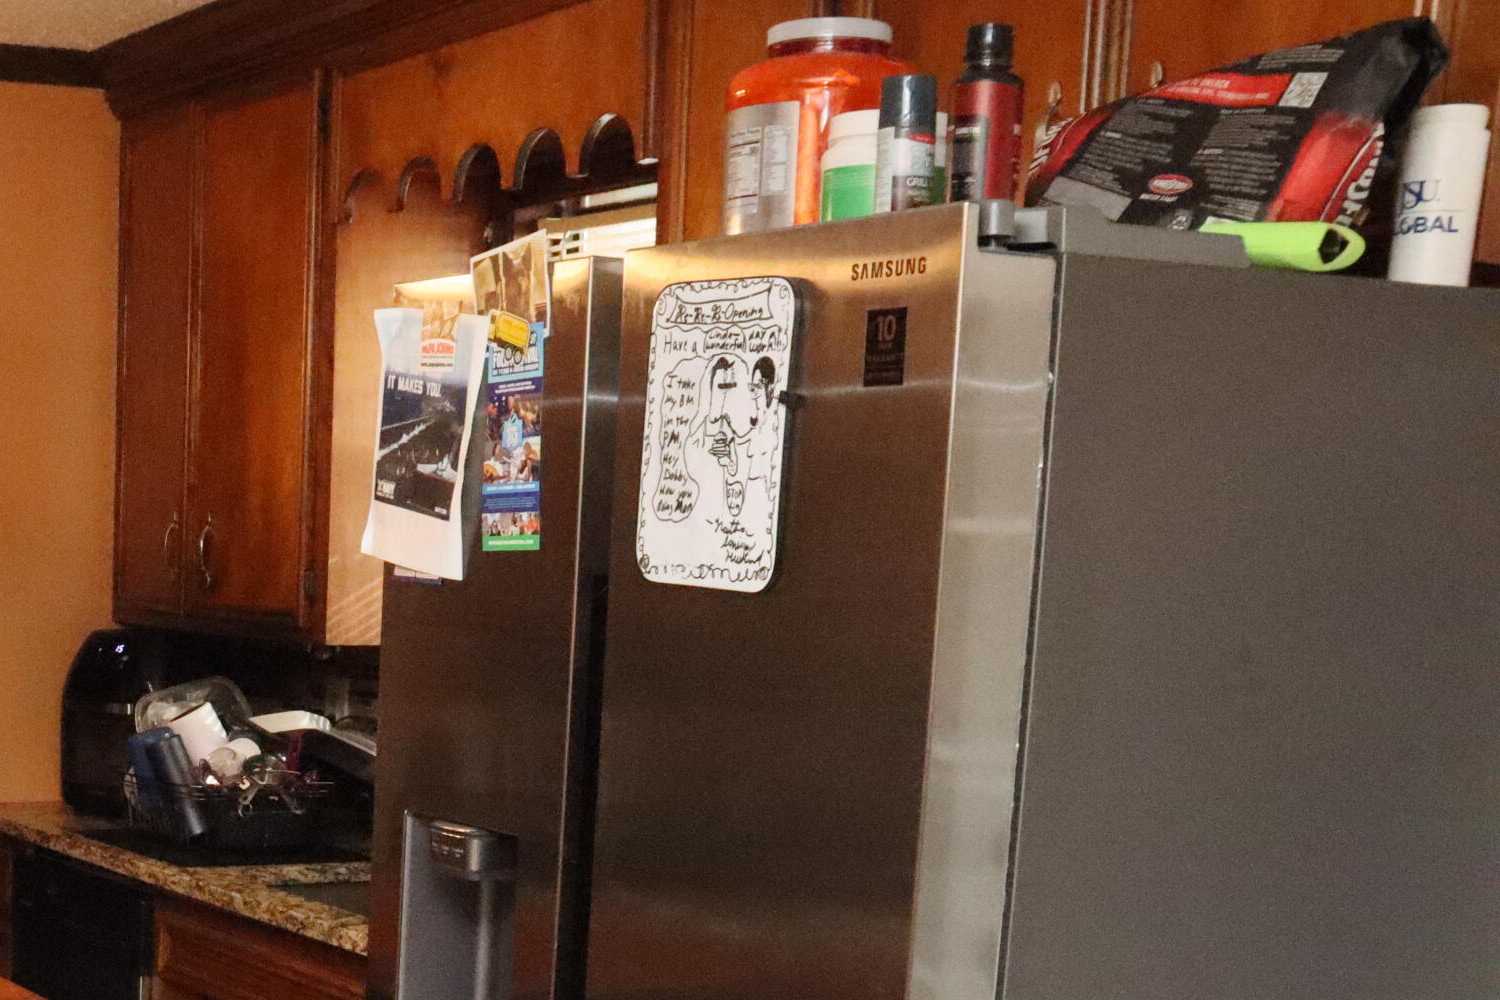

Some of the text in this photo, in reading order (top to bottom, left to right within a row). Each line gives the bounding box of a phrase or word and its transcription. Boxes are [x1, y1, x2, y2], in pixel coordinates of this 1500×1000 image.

[851, 256, 928, 281] SAMSUNG
[877, 315, 896, 341] 10
[663, 332, 688, 354] Have
[387, 374, 397, 390] IT
[397, 375, 424, 395] MAKES
